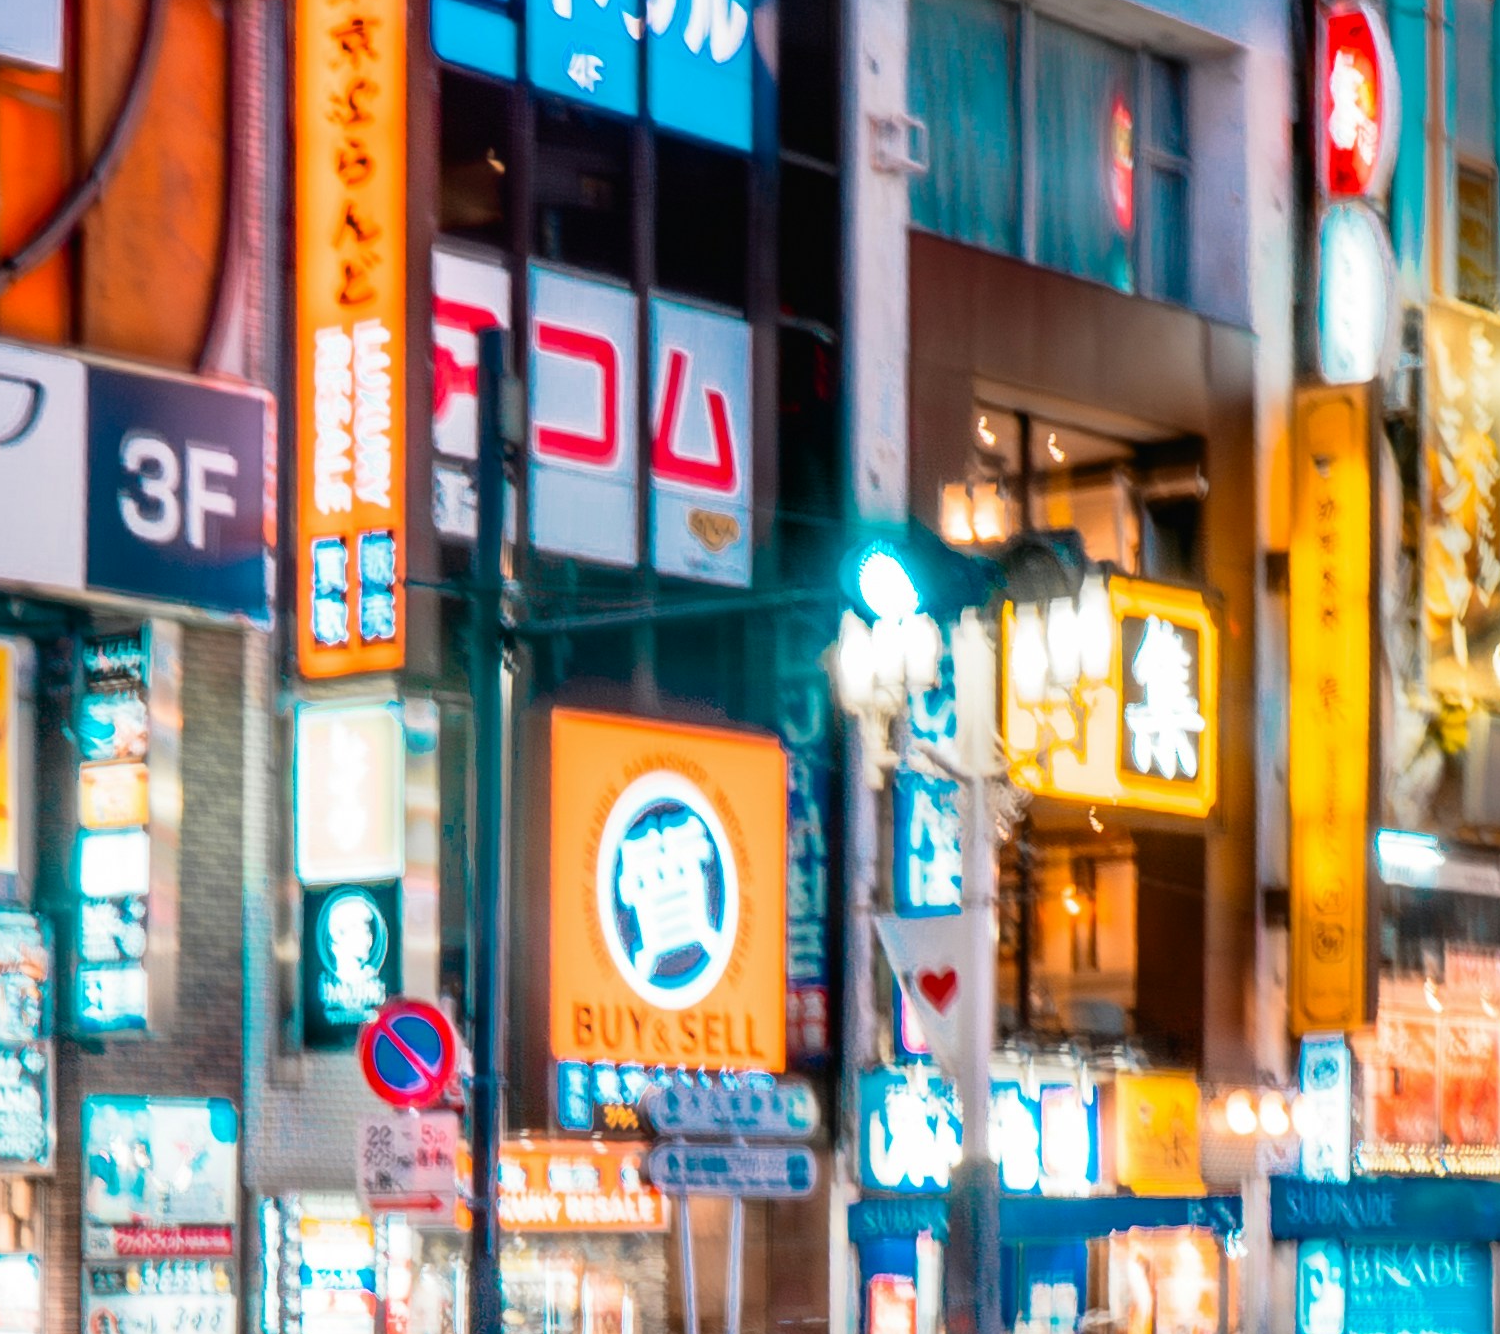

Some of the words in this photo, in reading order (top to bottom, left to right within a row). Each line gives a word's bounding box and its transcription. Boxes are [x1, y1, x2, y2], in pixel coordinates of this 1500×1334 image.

[119, 432, 240, 551] 3F
[571, 1000, 649, 1050] BUY
[678, 1010, 767, 1060] SELL
